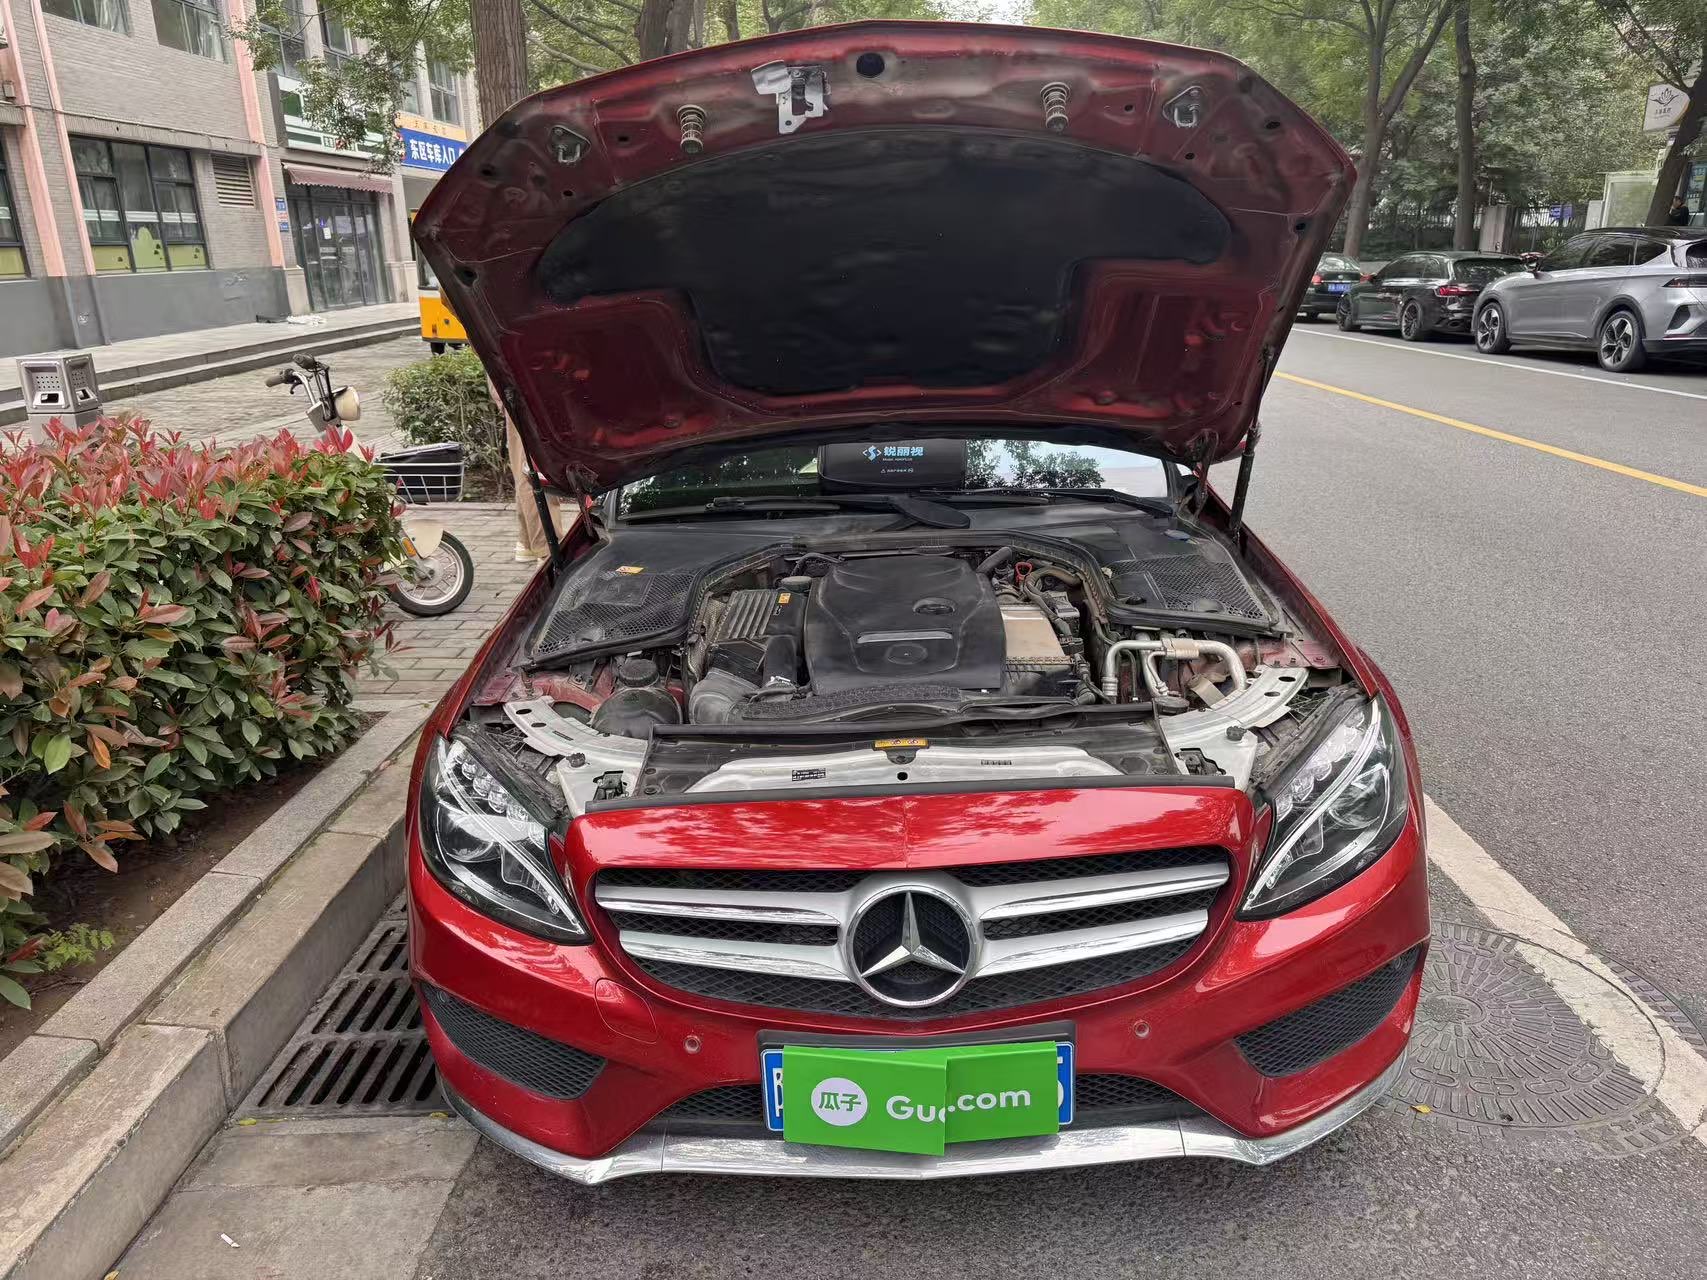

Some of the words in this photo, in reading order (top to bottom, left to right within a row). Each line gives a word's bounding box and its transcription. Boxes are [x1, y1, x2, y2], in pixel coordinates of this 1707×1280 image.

[409, 138, 455, 165] 东区车库入口
[883, 446, 924, 457] 锐丽视
[818, 1091, 861, 1112] 瓜子
